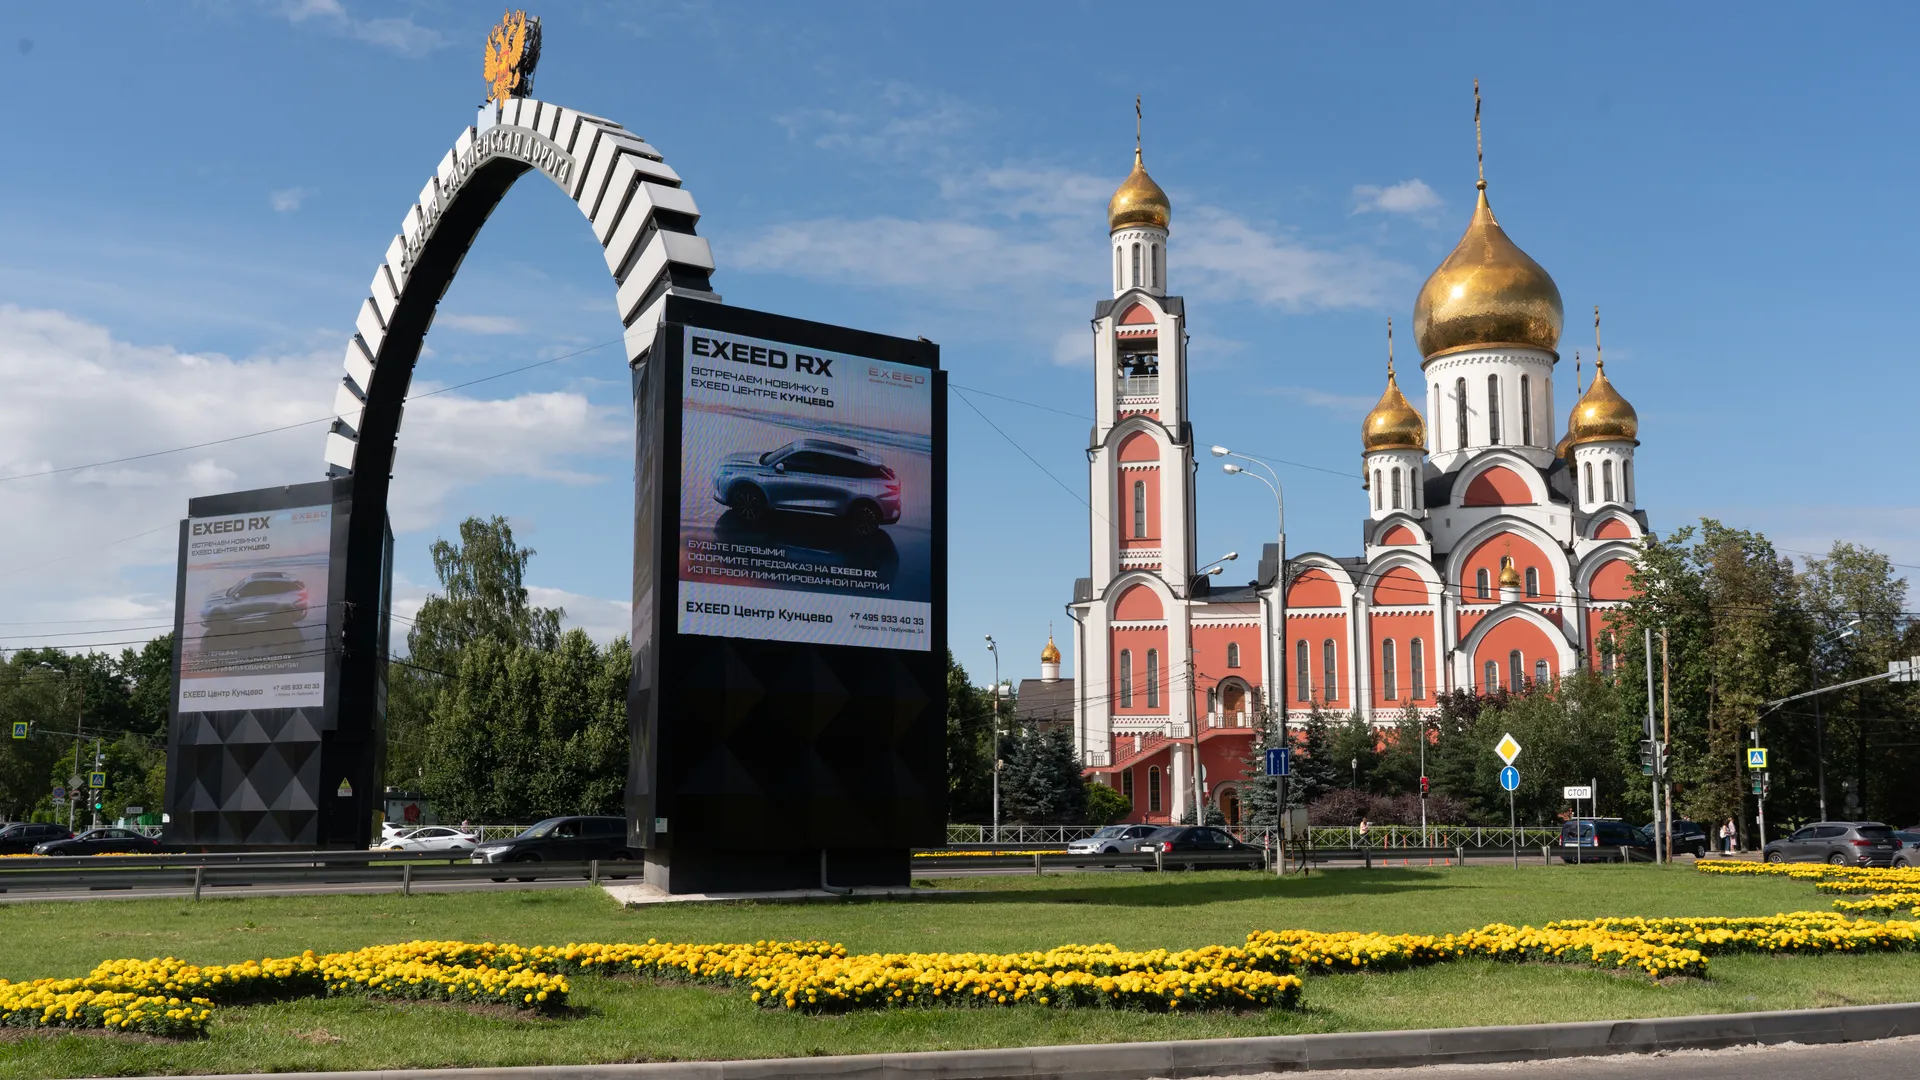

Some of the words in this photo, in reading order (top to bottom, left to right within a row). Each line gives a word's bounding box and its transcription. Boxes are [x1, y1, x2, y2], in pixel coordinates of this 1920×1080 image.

[400, 197, 441, 274] СТАРАЯ
[442, 129, 524, 200] СМОЛЕНСКАЯ
[524, 137, 573, 185] ДОРОГА
[691, 336, 788, 370] EXEED
[795, 353, 834, 378] RX
[691, 366, 763, 385] ВСТРЕЧАЕМ
[764, 377, 818, 394] НОВИНКУ
[821, 387, 829, 396] В
[868, 367, 925, 385] EXEED
[691, 378, 730, 393] EXEED
[732, 384, 778, 400] ЦЕНТРЕ
[779, 392, 835, 408] КУНЦЕВО
[193, 519, 245, 536] EXEED
[248, 516, 271, 531] RX
[192, 540, 230, 549] ВСТРЕЧАЕМ
[212, 547, 238, 555] ЦЕНТРЕ
[238, 543, 271, 552] КУНЦЕВО
[688, 540, 730, 552] БУДЬТЕ
[731, 544, 785, 557] ПЕРВЫМИ!
[688, 552, 749, 566] ОФОРМИТЕ
[750, 558, 813, 573] ПРЕДЗАКАЗ
[814, 564, 829, 573] НА
[830, 566, 863, 577] EXEED
[864, 569, 878, 578] RX
[687, 564, 704, 574] ИЗ
[705, 566, 749, 579] ПЕРВОЙ
[750, 570, 849, 588] ЛИМИТИРОВАННОЙ
[850, 580, 890, 591] ПАРТИИ
[685, 601, 731, 616] EXEED
[734, 605, 775, 620] Центр
[778, 608, 833, 624] Кунцево
[849, 612, 860, 620] +7
[862, 613, 879, 622] 495
[881, 615, 898, 623] 933
[900, 616, 911, 624] 40
[913, 617, 924, 625] 33
[183, 689, 207, 699] EXEED
[208, 689, 231, 698] Центр
[231, 688, 263, 698] Кунцево
[1567, 788, 1588, 797] СТОП
